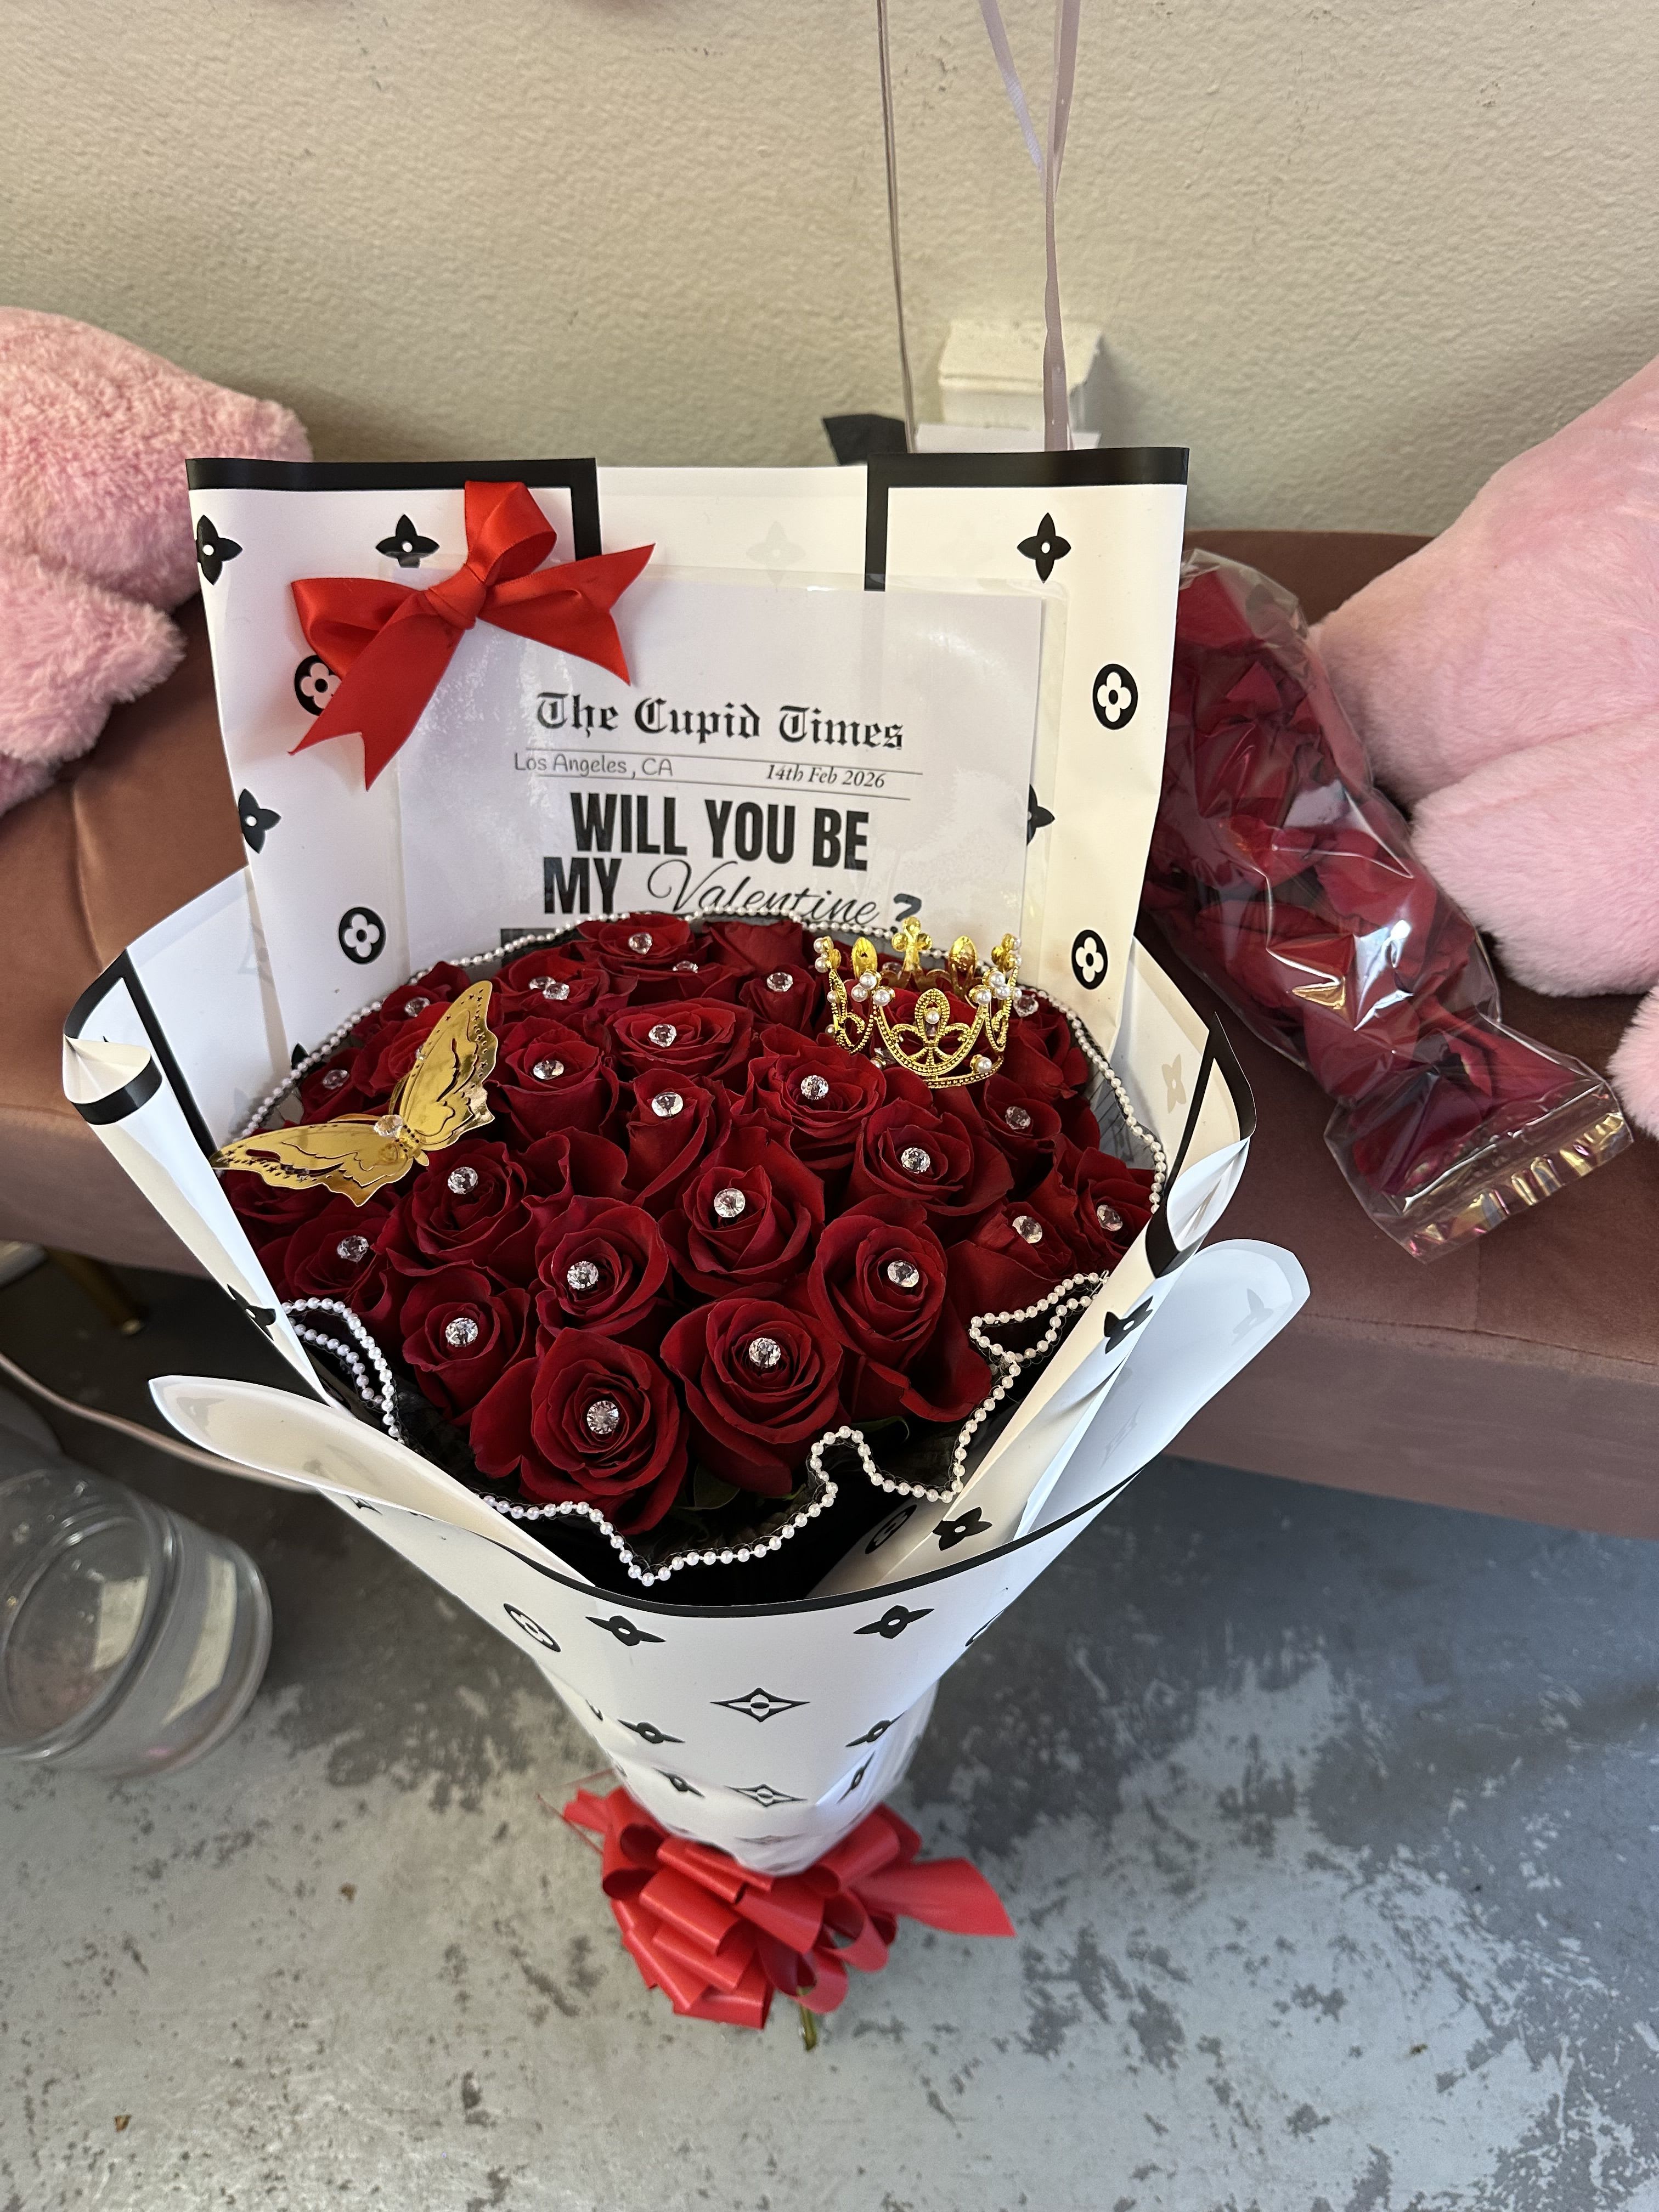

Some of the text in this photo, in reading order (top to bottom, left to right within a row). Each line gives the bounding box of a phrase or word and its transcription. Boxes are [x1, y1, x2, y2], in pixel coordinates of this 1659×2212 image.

[537, 692, 904, 751] The Cupid Times
[514, 752, 547, 771] Los
[642, 758, 673, 776] CA
[766, 763, 887, 788] 14th Feb 2026
[571, 792, 869, 871] WILL YOU BE
[543, 857, 622, 915] MY
[647, 859, 881, 925] Valentine
